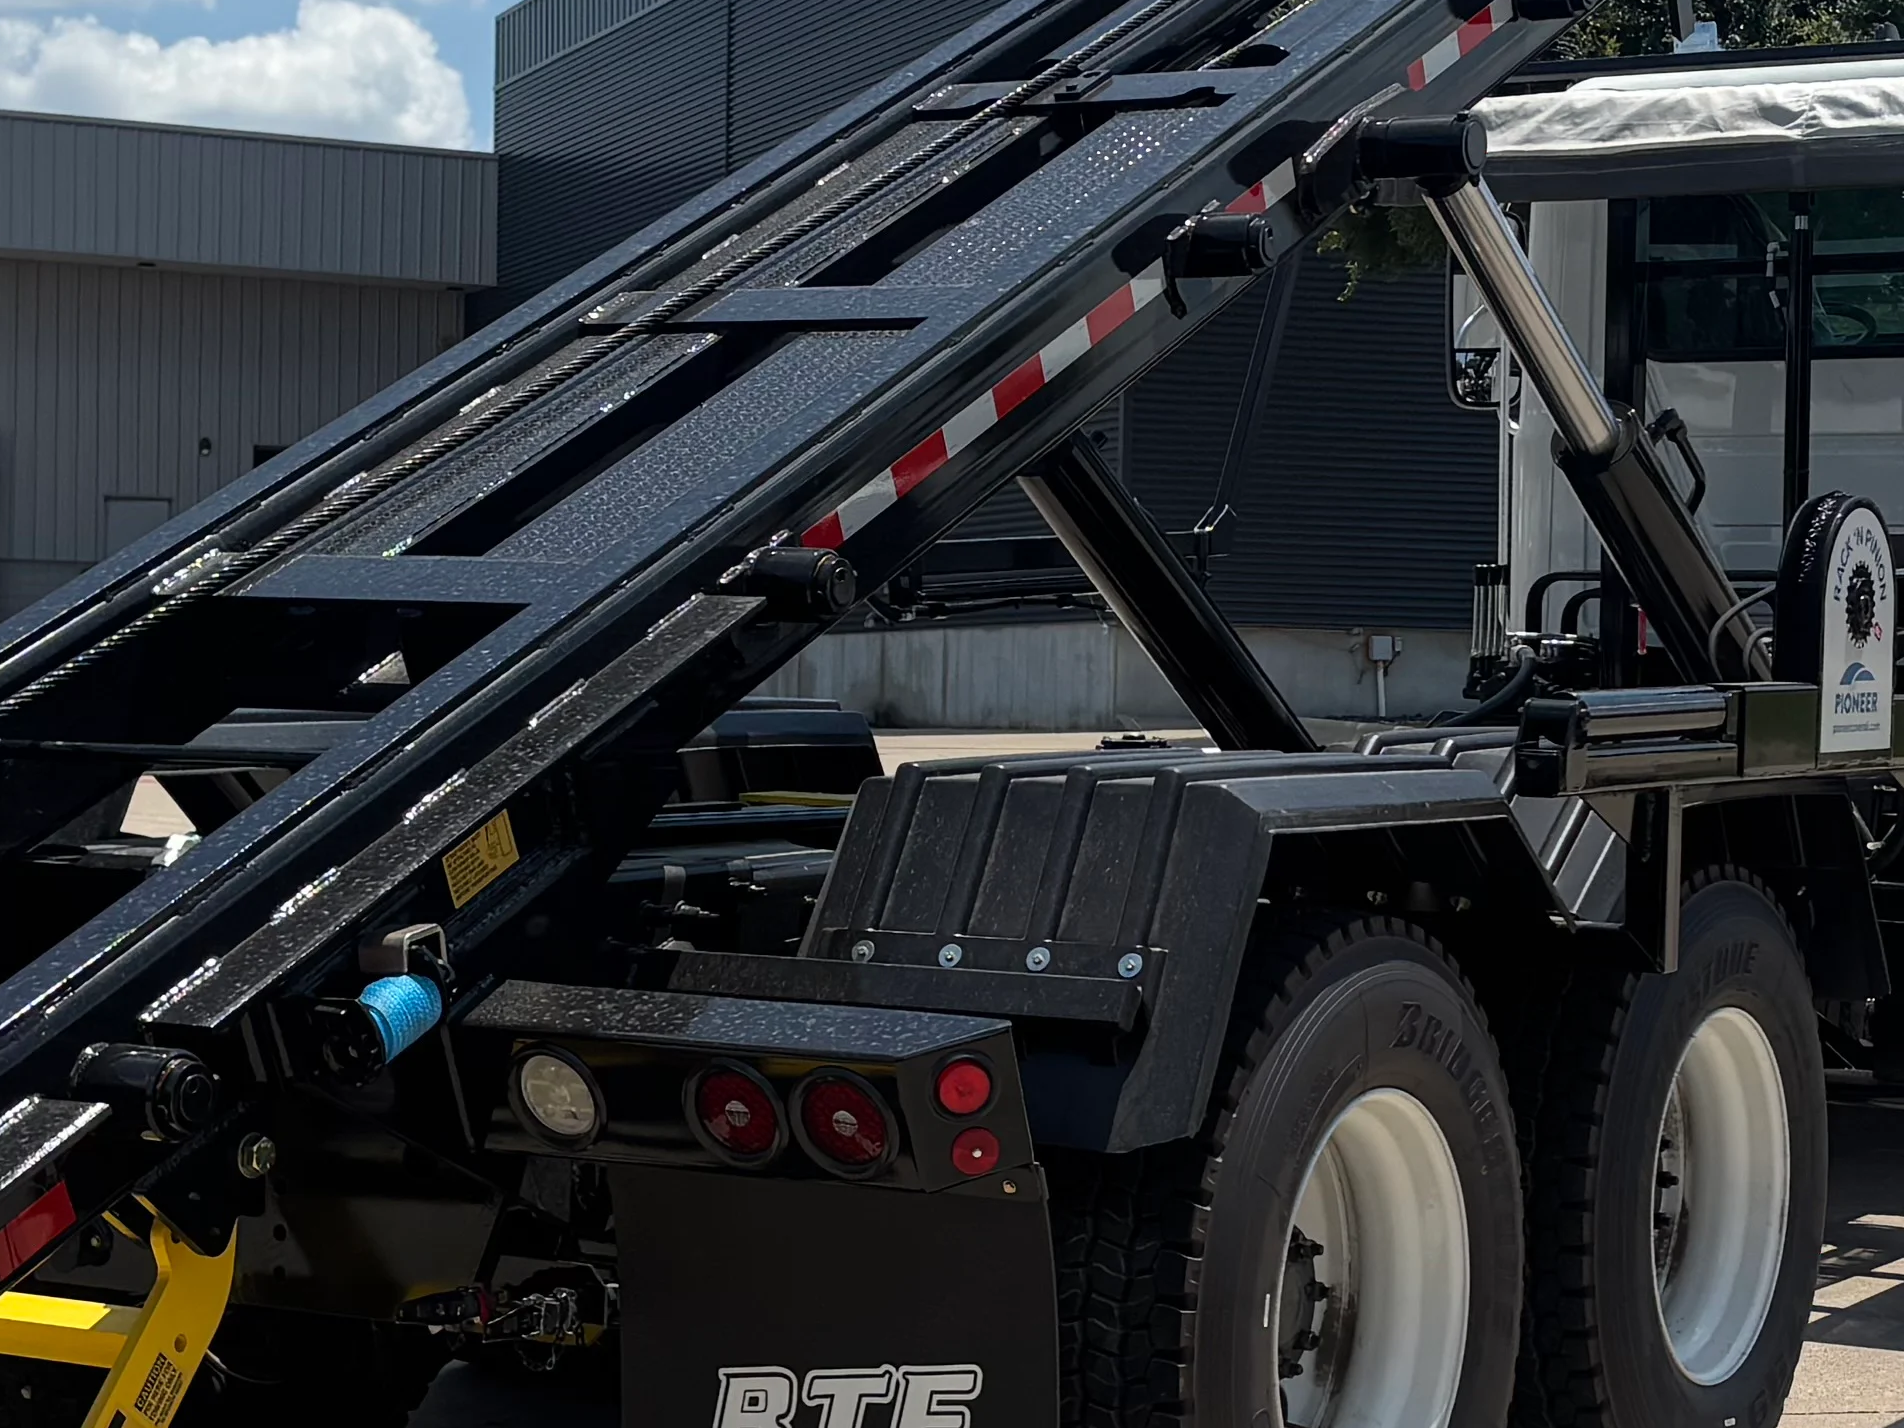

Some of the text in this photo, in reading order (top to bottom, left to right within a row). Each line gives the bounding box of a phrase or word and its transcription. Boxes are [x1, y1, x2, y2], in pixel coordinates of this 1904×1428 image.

[1833, 534, 1854, 602] RACK
[1864, 528, 1887, 602] PINION
[1834, 692, 1878, 714] PIONEER
[135, 1355, 166, 1407] CAUTION
